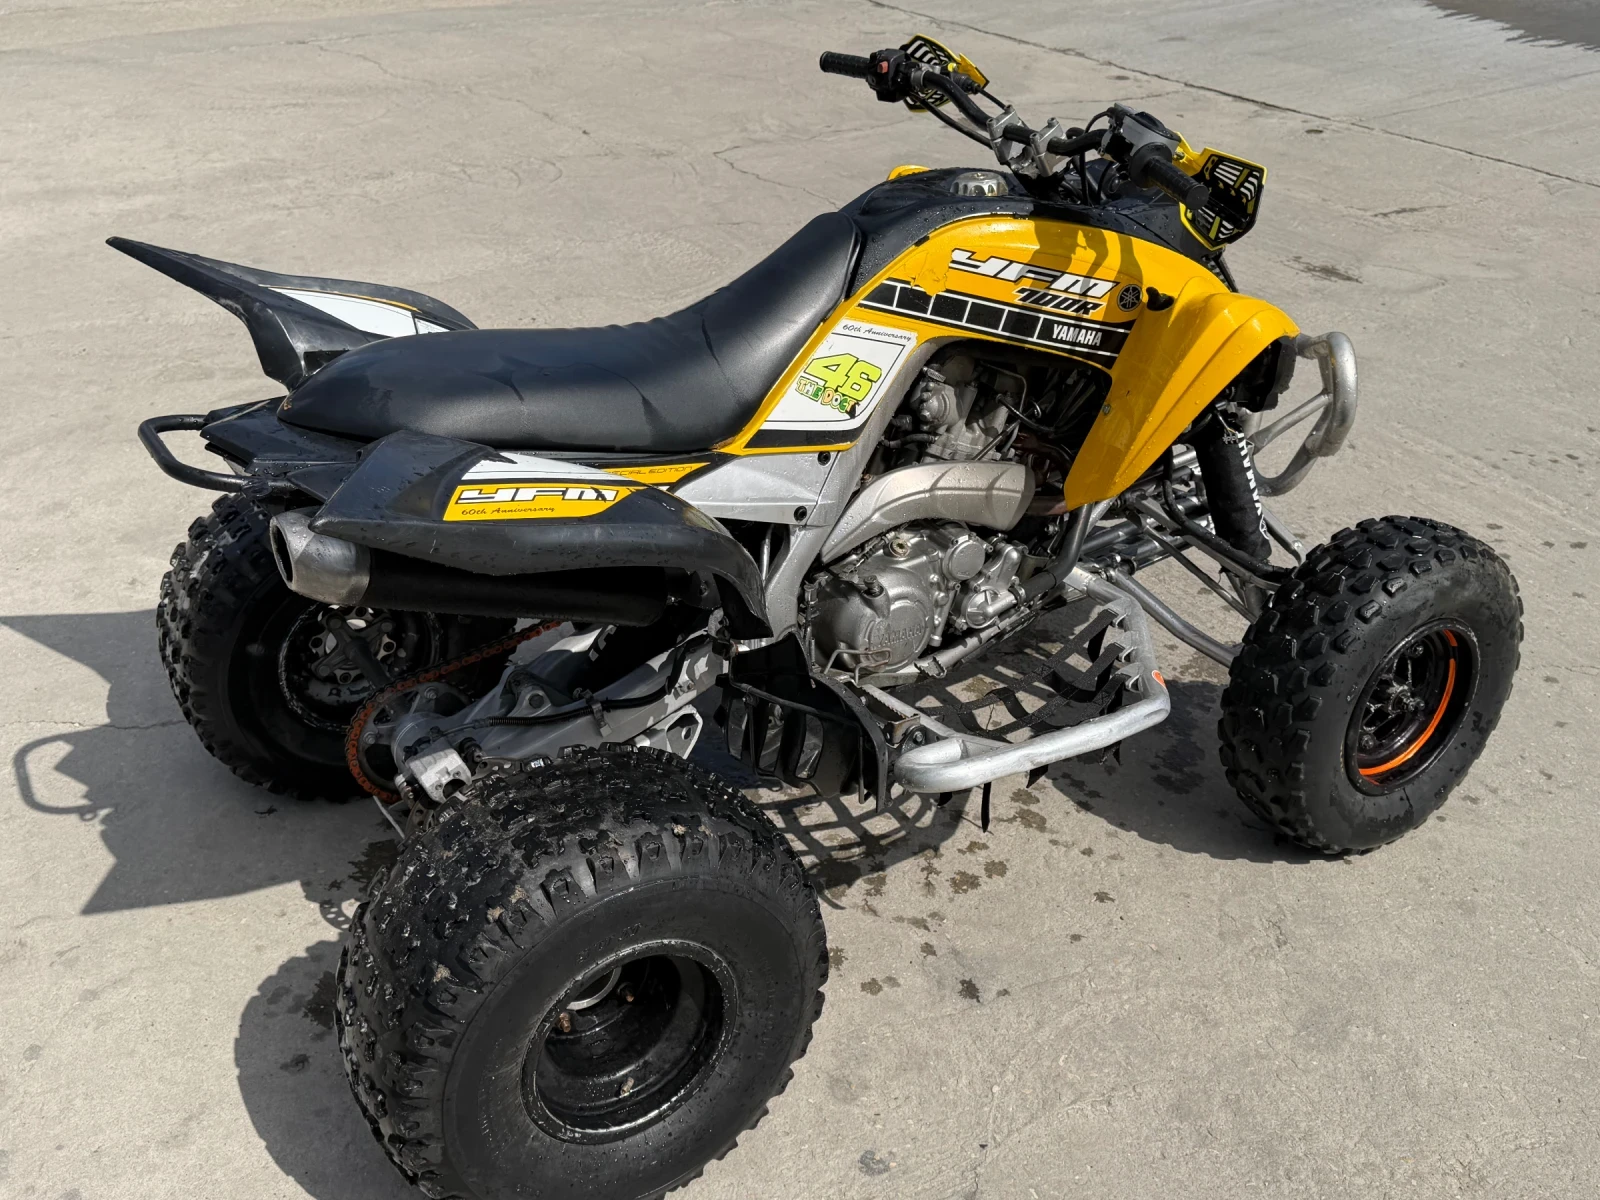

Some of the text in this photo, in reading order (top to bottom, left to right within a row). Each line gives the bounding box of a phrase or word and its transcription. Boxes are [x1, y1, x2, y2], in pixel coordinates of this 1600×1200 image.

[949, 247, 1120, 298] YFM
[842, 323, 911, 342] 60th Anniversary
[1052, 323, 1103, 346] YAMAHA
[795, 375, 824, 402] THE
[803, 353, 883, 402] 46
[455, 487, 619, 505] YFM
[461, 506, 556, 516] 60th Anniversary
